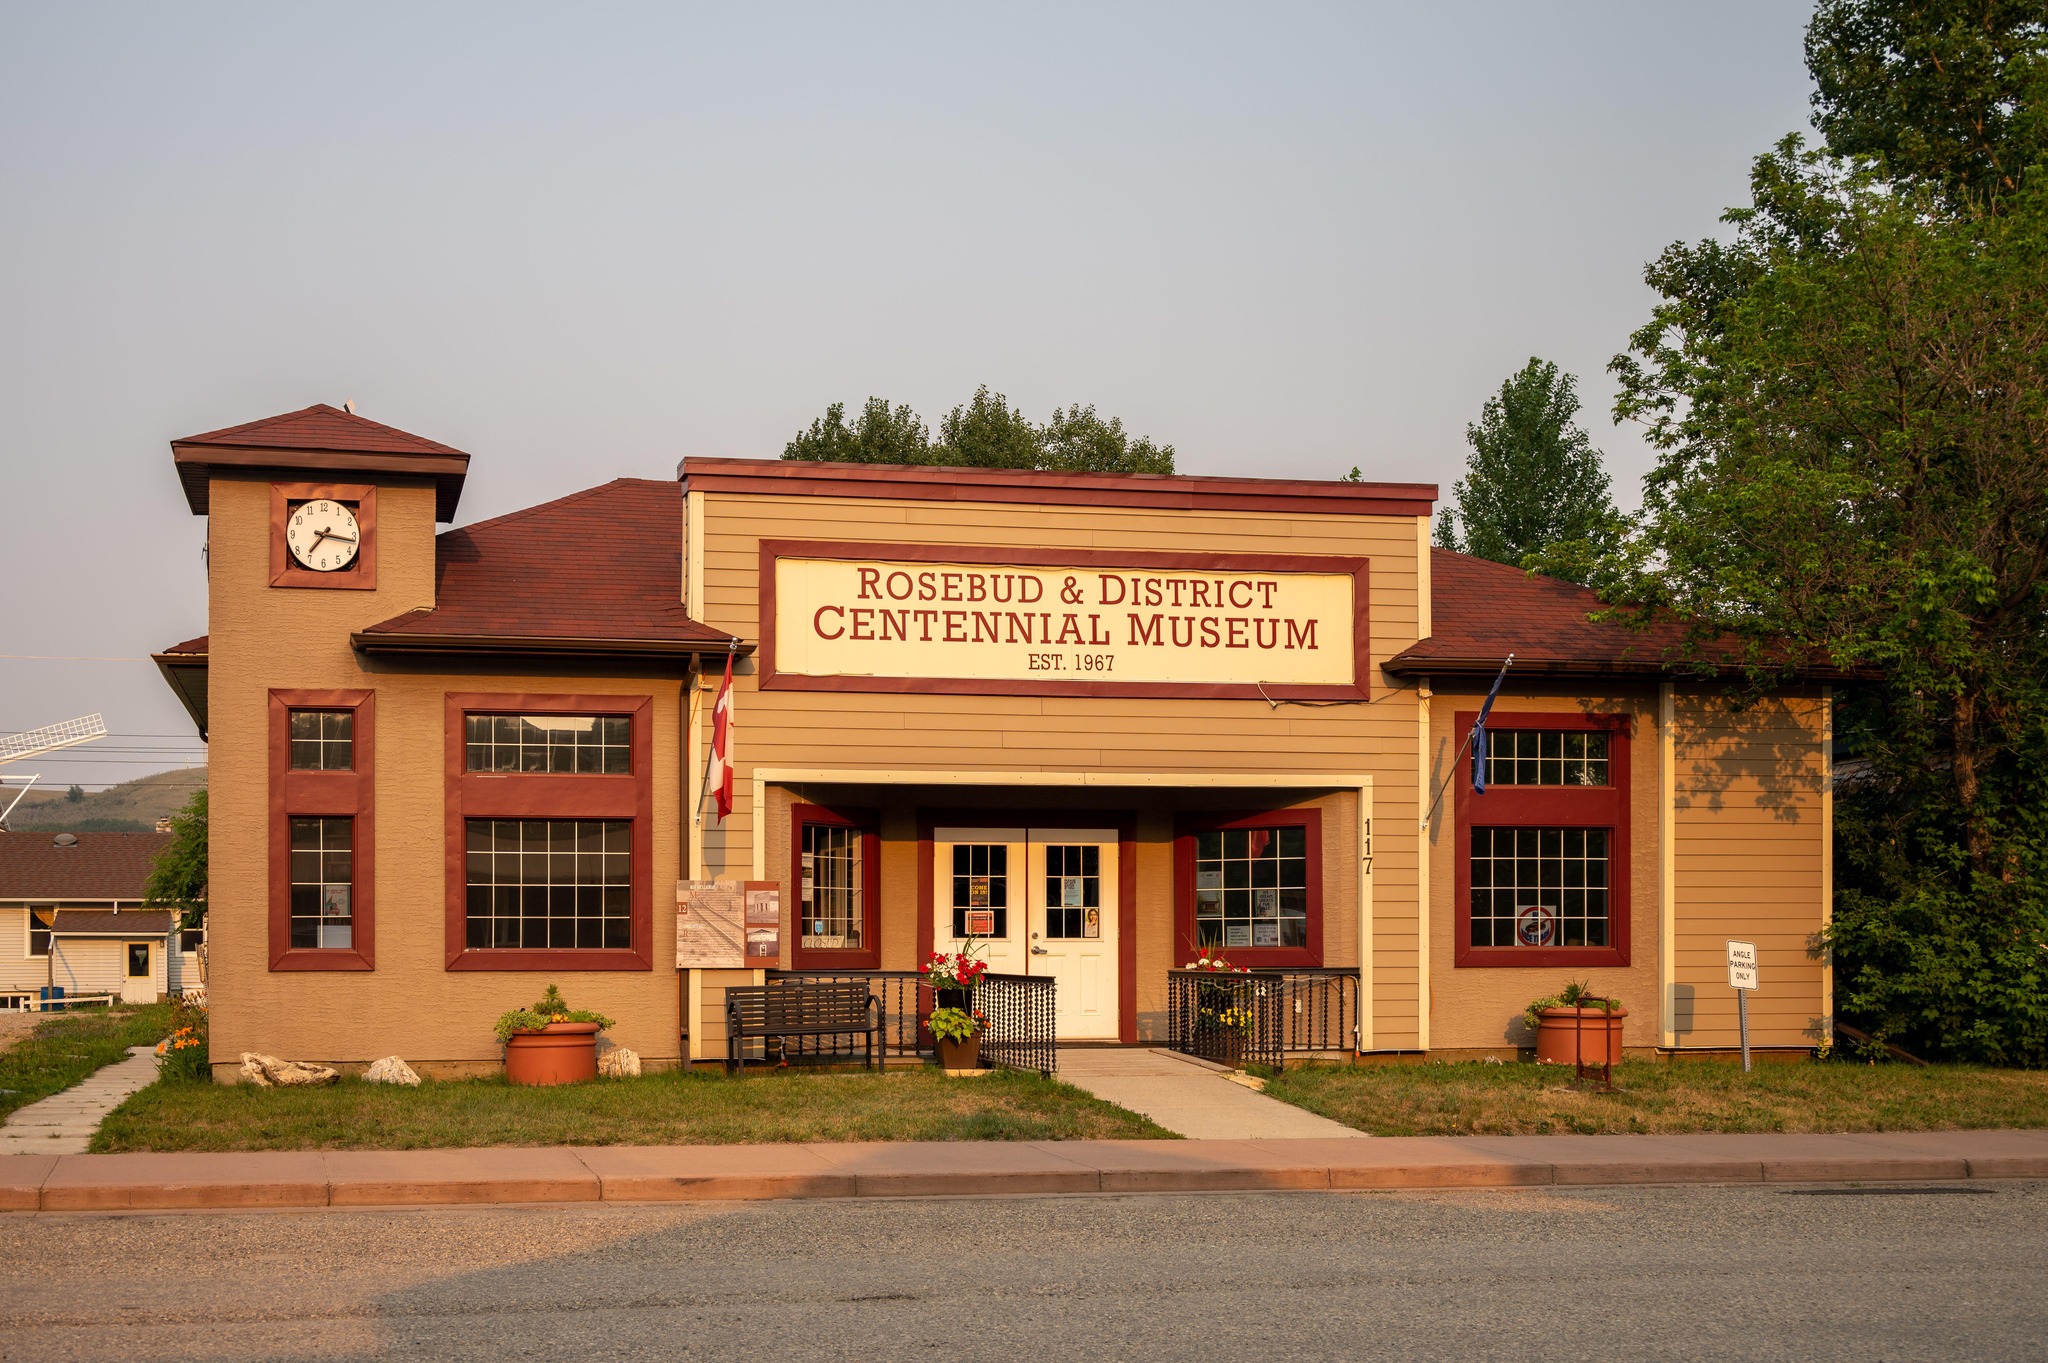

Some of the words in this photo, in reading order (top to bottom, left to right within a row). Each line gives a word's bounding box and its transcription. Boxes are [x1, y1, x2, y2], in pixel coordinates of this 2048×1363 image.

[307, 506, 313, 515] 11
[320, 502, 328, 512] 12
[336, 507, 340, 516] 1
[295, 516, 302, 525] 10
[348, 517, 352, 526] 2
[290, 530, 296, 539] 9
[351, 532, 357, 541] 3
[295, 546, 300, 555] 8
[347, 546, 352, 556] 4
[308, 555, 312, 564] 7
[321, 558, 326, 568] 6
[336, 555, 341, 564] 5
[857, 567, 1043, 604] ROSEBUD
[1060, 575, 1084, 605] &
[1099, 574, 1278, 609] DISTRICT
[813, 605, 1110, 646] CENTENNIAL
[1128, 613, 1319, 650] MUSEUM
[1028, 653, 1067, 671] EST.
[1074, 654, 1115, 672] 1967
[1362, 818, 1373, 874] 117
[678, 904, 687, 912] 12
[1733, 950, 1751, 959] ANGLE
[1730, 960, 1756, 970] PARKING
[1736, 972, 1750, 980] ONLY
